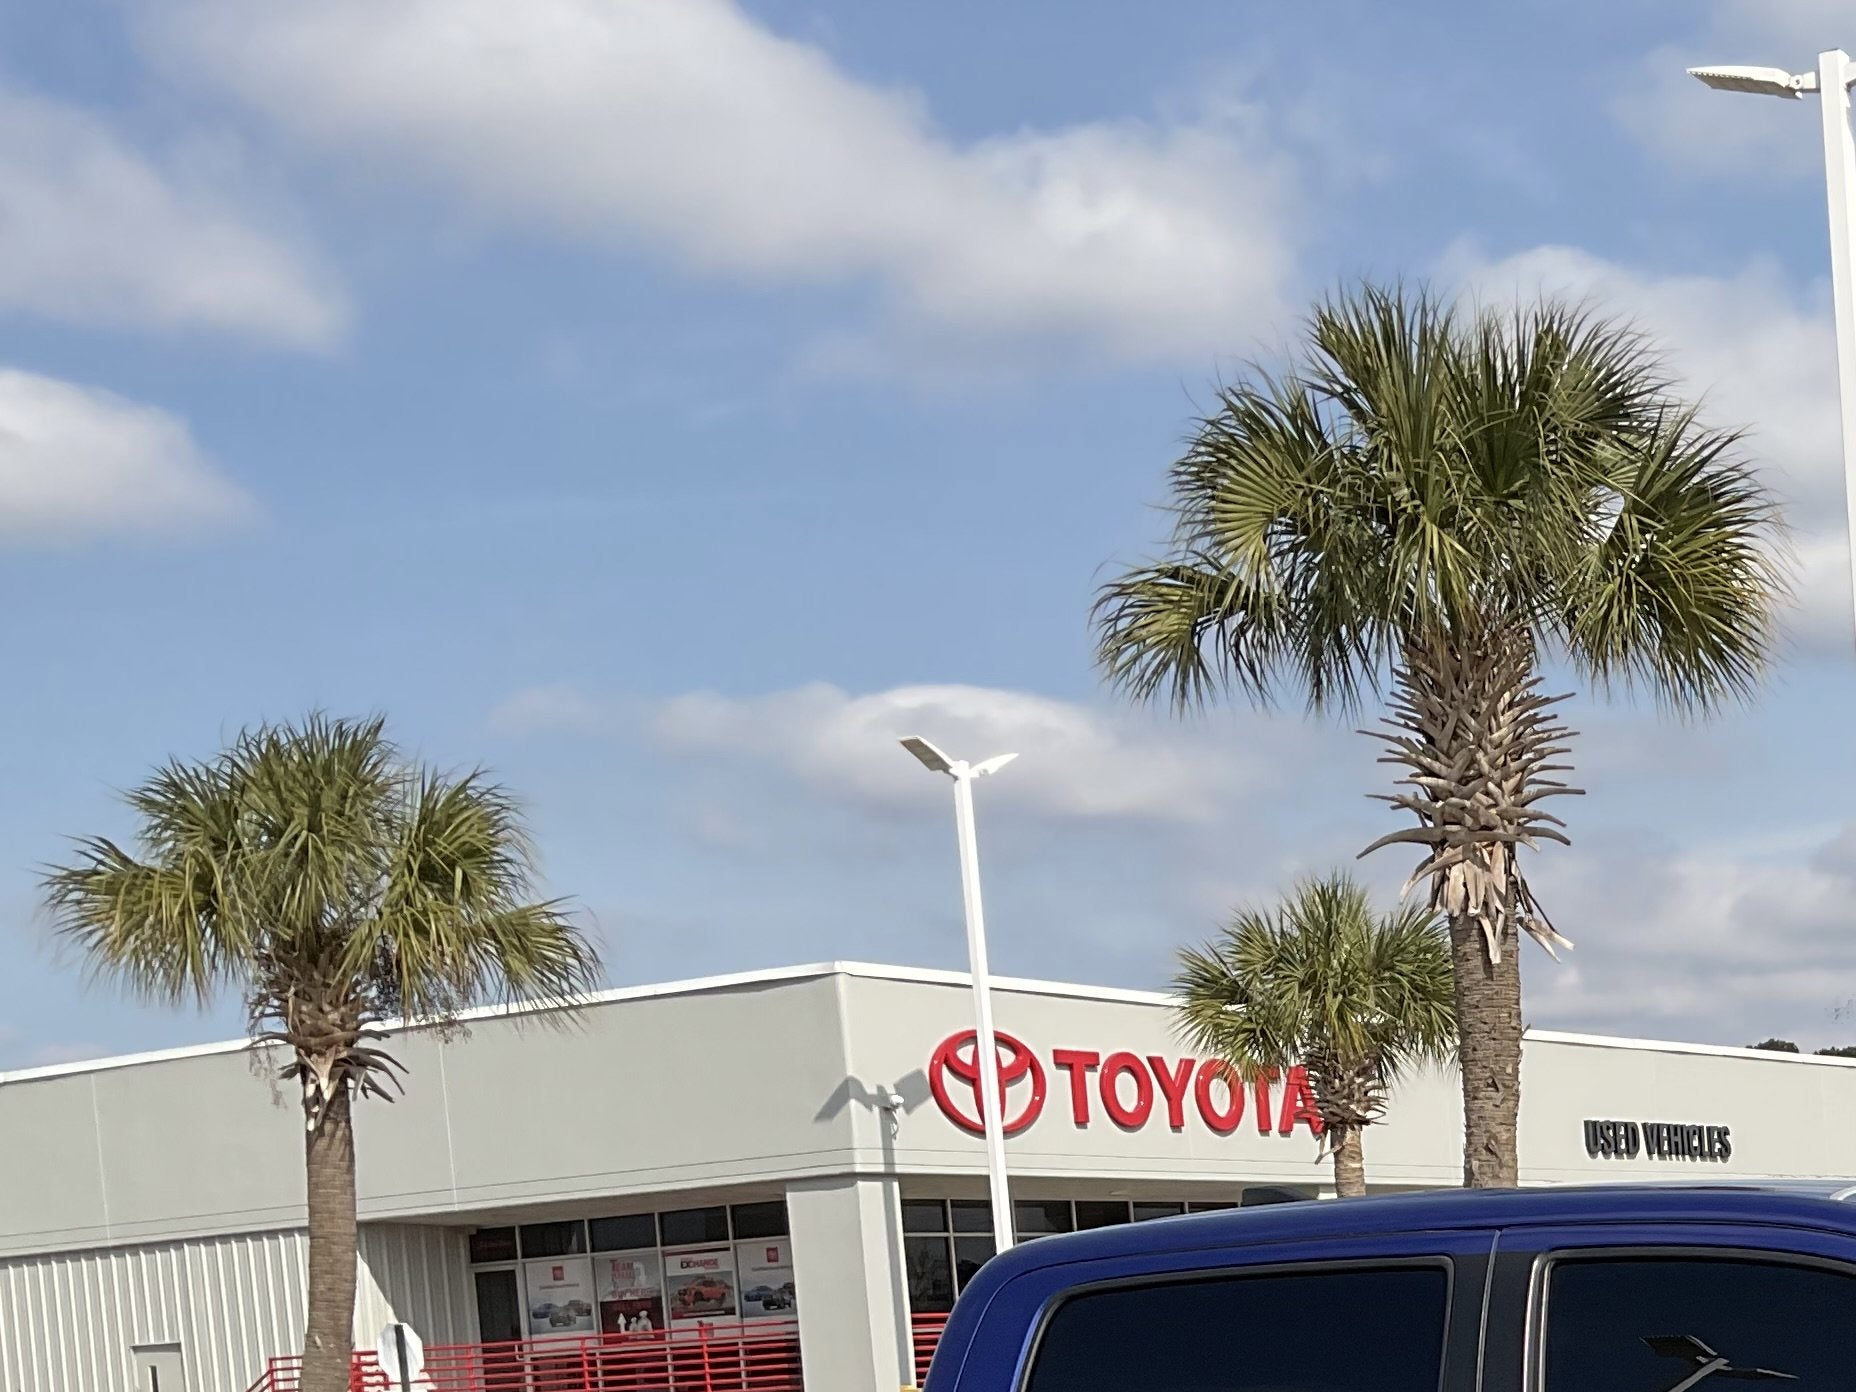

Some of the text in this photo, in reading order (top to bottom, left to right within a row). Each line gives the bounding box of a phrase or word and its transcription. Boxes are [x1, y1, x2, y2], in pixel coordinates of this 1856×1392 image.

[1053, 1049, 1324, 1133] TOYOTA
[1584, 1120, 1732, 1160] USED VEHICLES
